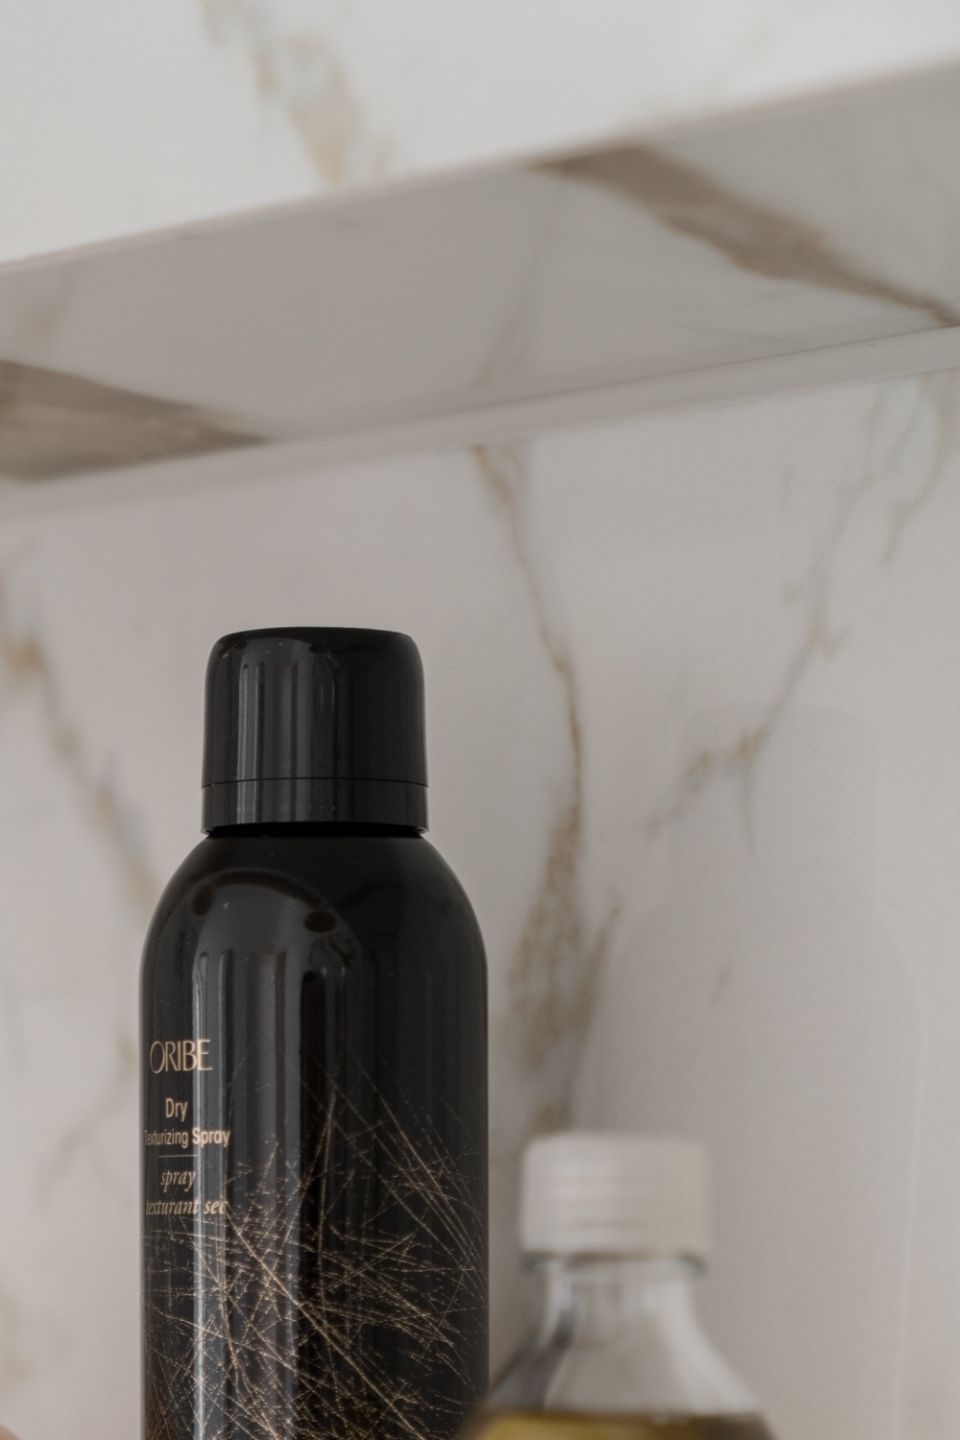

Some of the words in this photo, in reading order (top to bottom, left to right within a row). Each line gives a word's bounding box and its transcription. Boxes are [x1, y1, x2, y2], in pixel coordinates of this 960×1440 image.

[150, 1039, 213, 1074] ORIBE
[165, 1097, 188, 1123] Dry
[192, 1127, 230, 1148] Spray
[161, 1170, 196, 1193] spray
[203, 1200, 227, 1215] sec
